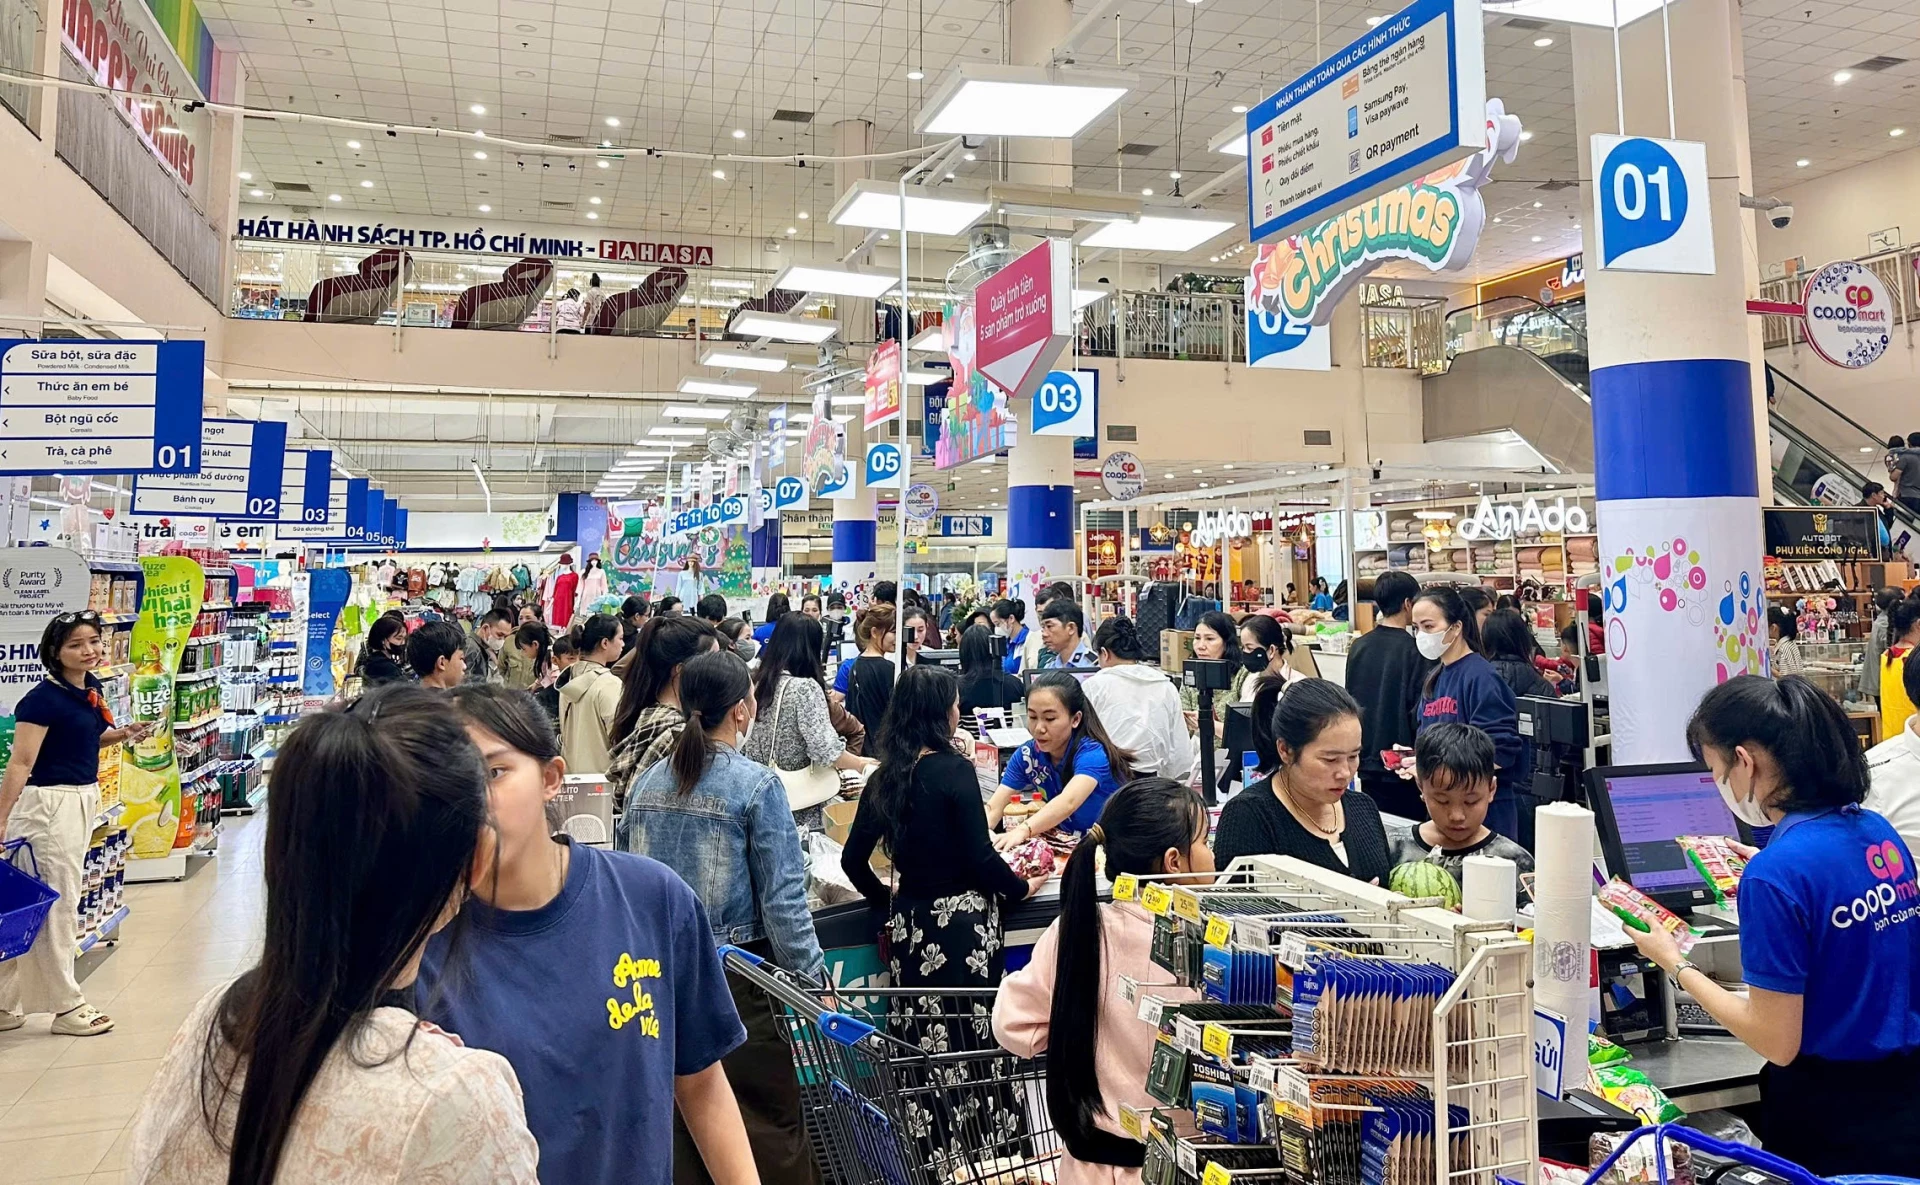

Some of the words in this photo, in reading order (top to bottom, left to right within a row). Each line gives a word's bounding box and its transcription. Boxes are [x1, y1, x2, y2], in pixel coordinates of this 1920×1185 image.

[1407, 34, 1425, 50] hàng
[1275, 90, 1293, 111] NHẬN
[1293, 75, 1316, 97] THANH
[1316, 65, 1335, 86] TOÁN
[1336, 56, 1351, 74] QUA
[1352, 44, 1366, 61] CÁC
[1367, 31, 1387, 51] HÌNH
[1388, 16, 1410, 38] THỨC
[62, 0, 138, 113] HAPPY
[140, 84, 195, 186] GAMES
[1364, 92, 1393, 112] Samsung
[1365, 110, 1378, 125] Visa
[1379, 96, 1409, 121] paywave
[1290, 113, 1302, 130] mặt
[1292, 135, 1304, 146] mua
[1366, 143, 1378, 160] QR
[1380, 123, 1419, 153] payment
[1279, 173, 1290, 188] Quy
[1280, 193, 1294, 208] Thanh
[1307, 184, 1317, 199] qua
[1613, 162, 1672, 221] 01
[288, 218, 353, 242] HÀNH
[357, 223, 414, 246] SÁCH
[419, 230, 450, 248] TP.
[454, 227, 486, 250] HỒ
[489, 233, 525, 254] CHÍ
[529, 237, 583, 257] MINH
[600, 239, 713, 266] FAHASA
[1020, 273, 1034, 296] tiền
[980, 324, 985, 341] 5
[31, 350, 57, 360] Sữa
[61, 350, 84, 361] bột,
[87, 350, 111, 360] sữa
[115, 350, 137, 362] đặc
[37, 381, 69, 391] Thức
[73, 382, 88, 391] ăn
[114, 381, 129, 391] bé
[1040, 382, 1077, 412] 03
[45, 414, 66, 425] Bột
[70, 413, 93, 425] ngũ
[97, 411, 119, 424] cốc
[204, 426, 224, 437] ngọt
[45, 446, 67, 458] Trà,
[71, 446, 86, 456] cà
[89, 446, 112, 458] phê
[158, 445, 191, 468] 01
[211, 448, 231, 458] khát
[871, 452, 899, 472] 05
[214, 472, 245, 484] dưỡng
[780, 483, 800, 499] 07
[173, 494, 197, 504] Bánh
[198, 496, 215, 505] quy
[249, 498, 276, 515] 02
[305, 508, 325, 521] 03
[707, 508, 719, 520] 10
[724, 502, 741, 515] 09
[347, 526, 364, 537] 04
[366, 532, 380, 541] 05
[1801, 534, 1843, 542] AUTOBOT
[381, 536, 394, 545] 06
[1776, 546, 1794, 557] PHỤ
[1796, 544, 1816, 556] KIỆN
[1817, 544, 1843, 555] CÔNG
[142, 561, 166, 570] fuze
[20, 571, 46, 579] Purity
[180, 579, 190, 592] tí
[160, 594, 192, 613] hài
[153, 611, 192, 628] hòa
[1, 674, 25, 684] VIỆT
[132, 686, 171, 704] fuze
[133, 701, 162, 716] tea
[1874, 917, 1890, 932] bạn
[1891, 909, 1908, 923] của
[613, 952, 661, 988] Acme
[1303, 977, 1319, 991] FUJITSU
[640, 1009, 660, 1039] vie
[1193, 1063, 1231, 1083] TOSHIBA
[1373, 1118, 1390, 1134] FUJITSU
